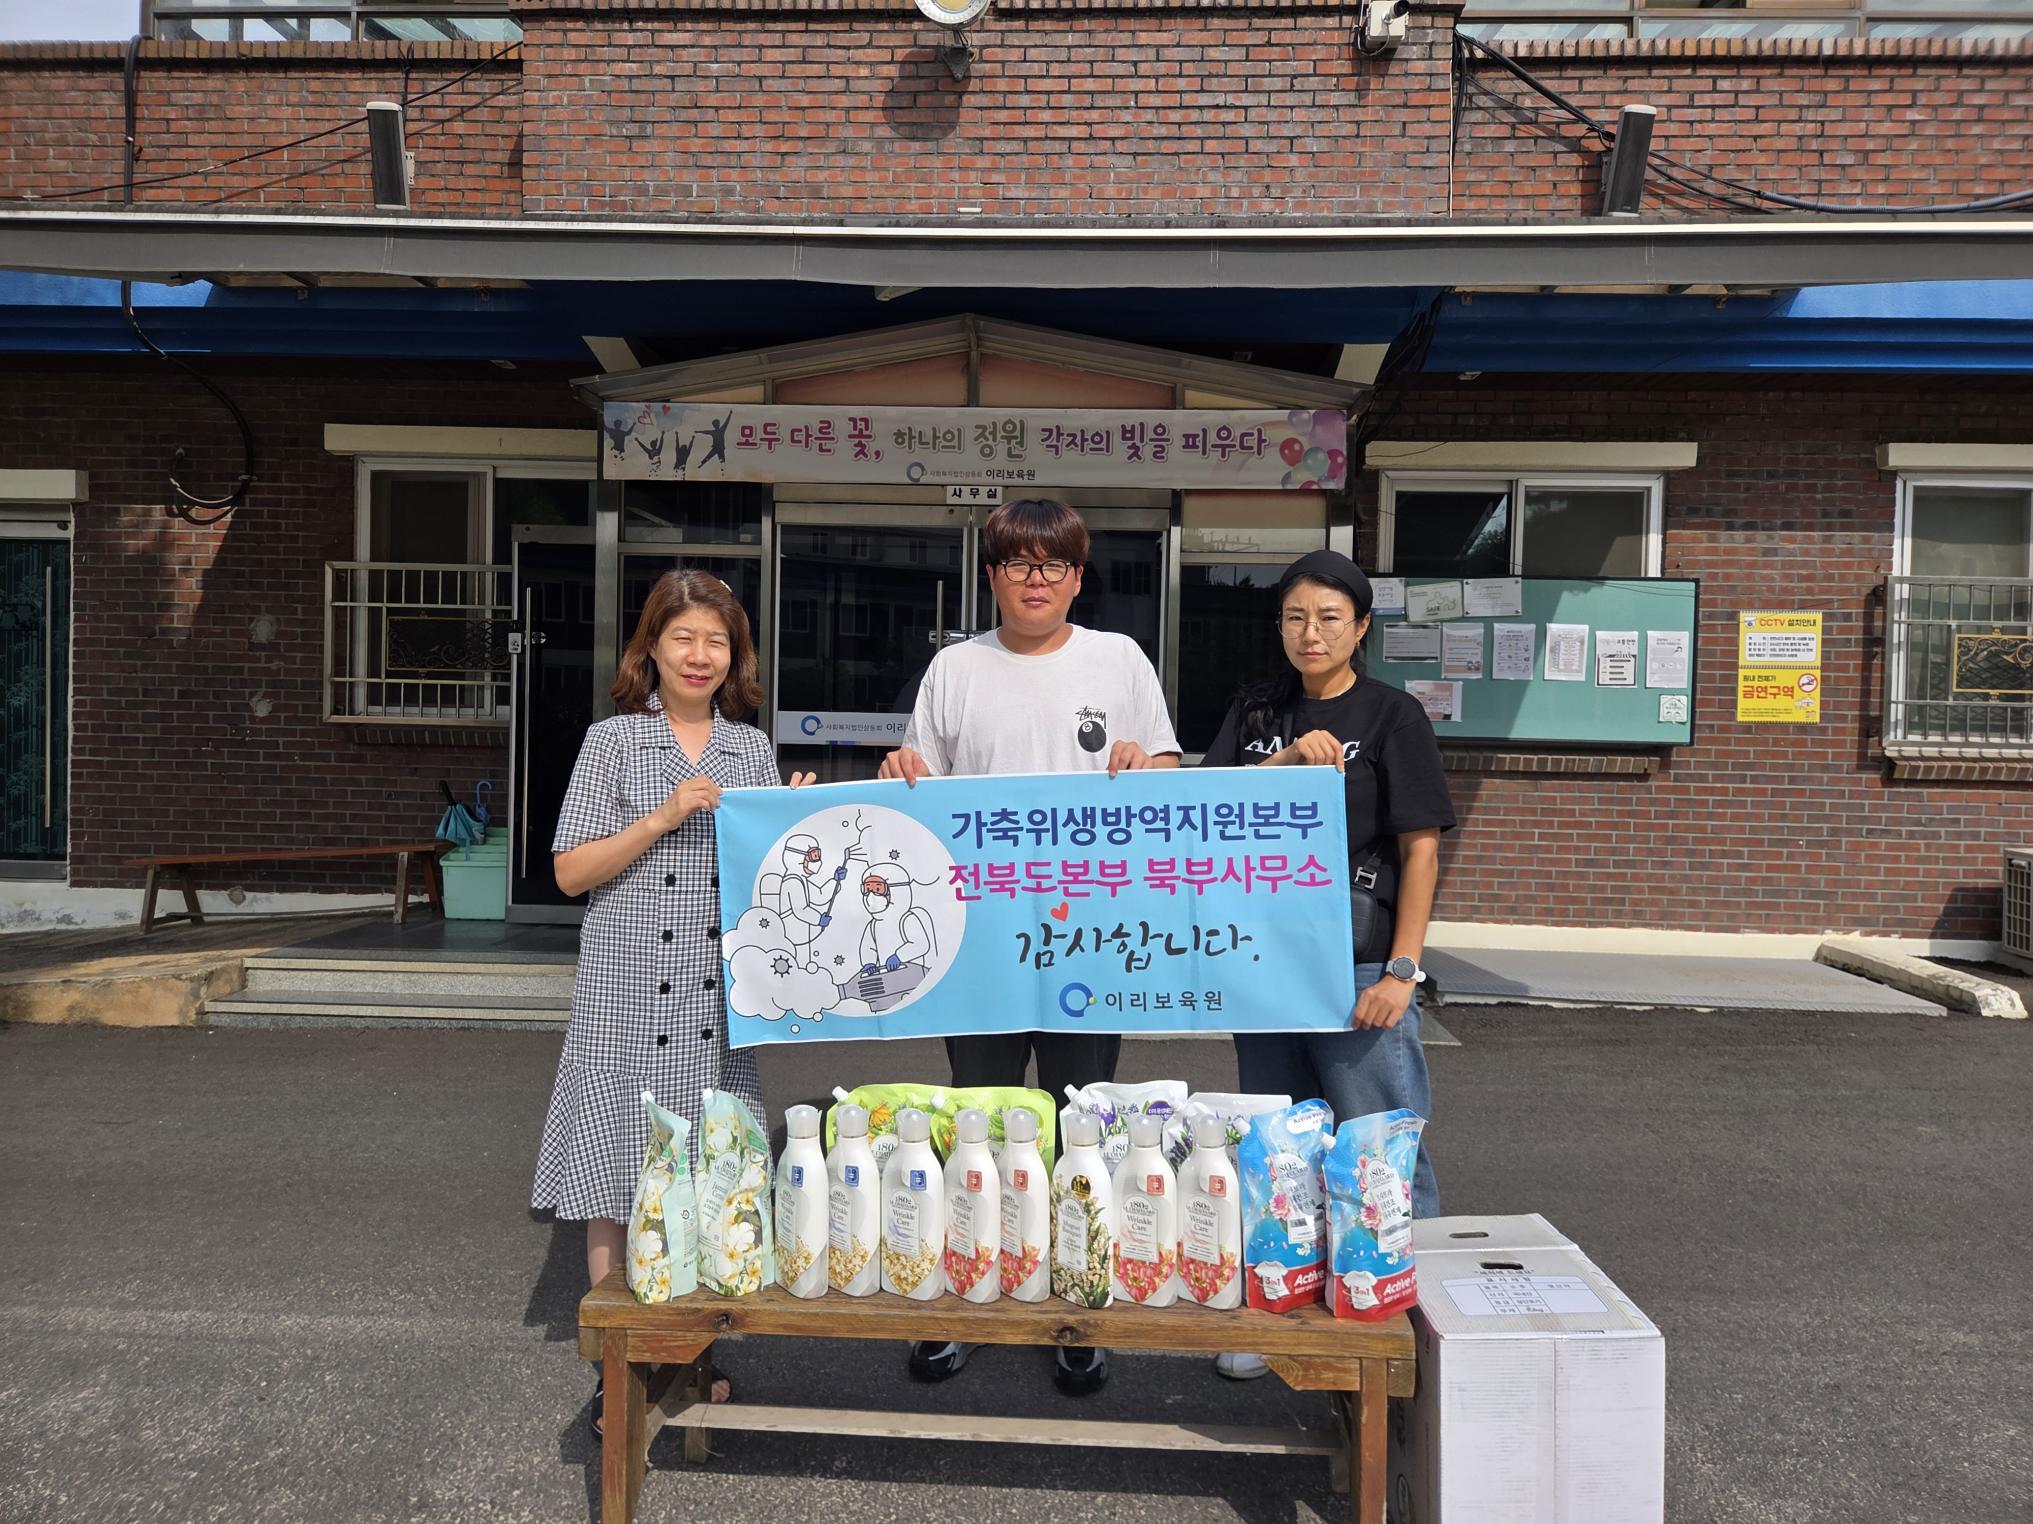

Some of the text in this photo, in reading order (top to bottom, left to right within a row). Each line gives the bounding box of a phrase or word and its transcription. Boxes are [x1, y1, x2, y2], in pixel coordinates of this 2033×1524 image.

[737, 416, 1268, 462] 모두 다른 꽃, 하나의 정원 각자의 빛을 피우다
[985, 469, 1036, 480] 이리보육원
[1759, 618, 1817, 627] CCTV 설치안내
[1742, 685, 1795, 699] 금연구역
[951, 801, 1324, 849] 가축위생방역지원본부
[947, 852, 1333, 902] 전북도본부 북부사무소
[1015, 920, 1261, 973] 감사합니다.
[1104, 988, 1224, 1014] 이리보육원
[892, 1208, 915, 1220] Wrinkle
[1127, 1214, 1152, 1225] Wrinkle
[1189, 1214, 1215, 1227] Wrinkle
[896, 1217, 909, 1226] Care
[1132, 1223, 1147, 1231] Care
[1194, 1224, 1208, 1232] Care
[1294, 1270, 1325, 1287] Active
[1383, 1277, 1411, 1296] Active
